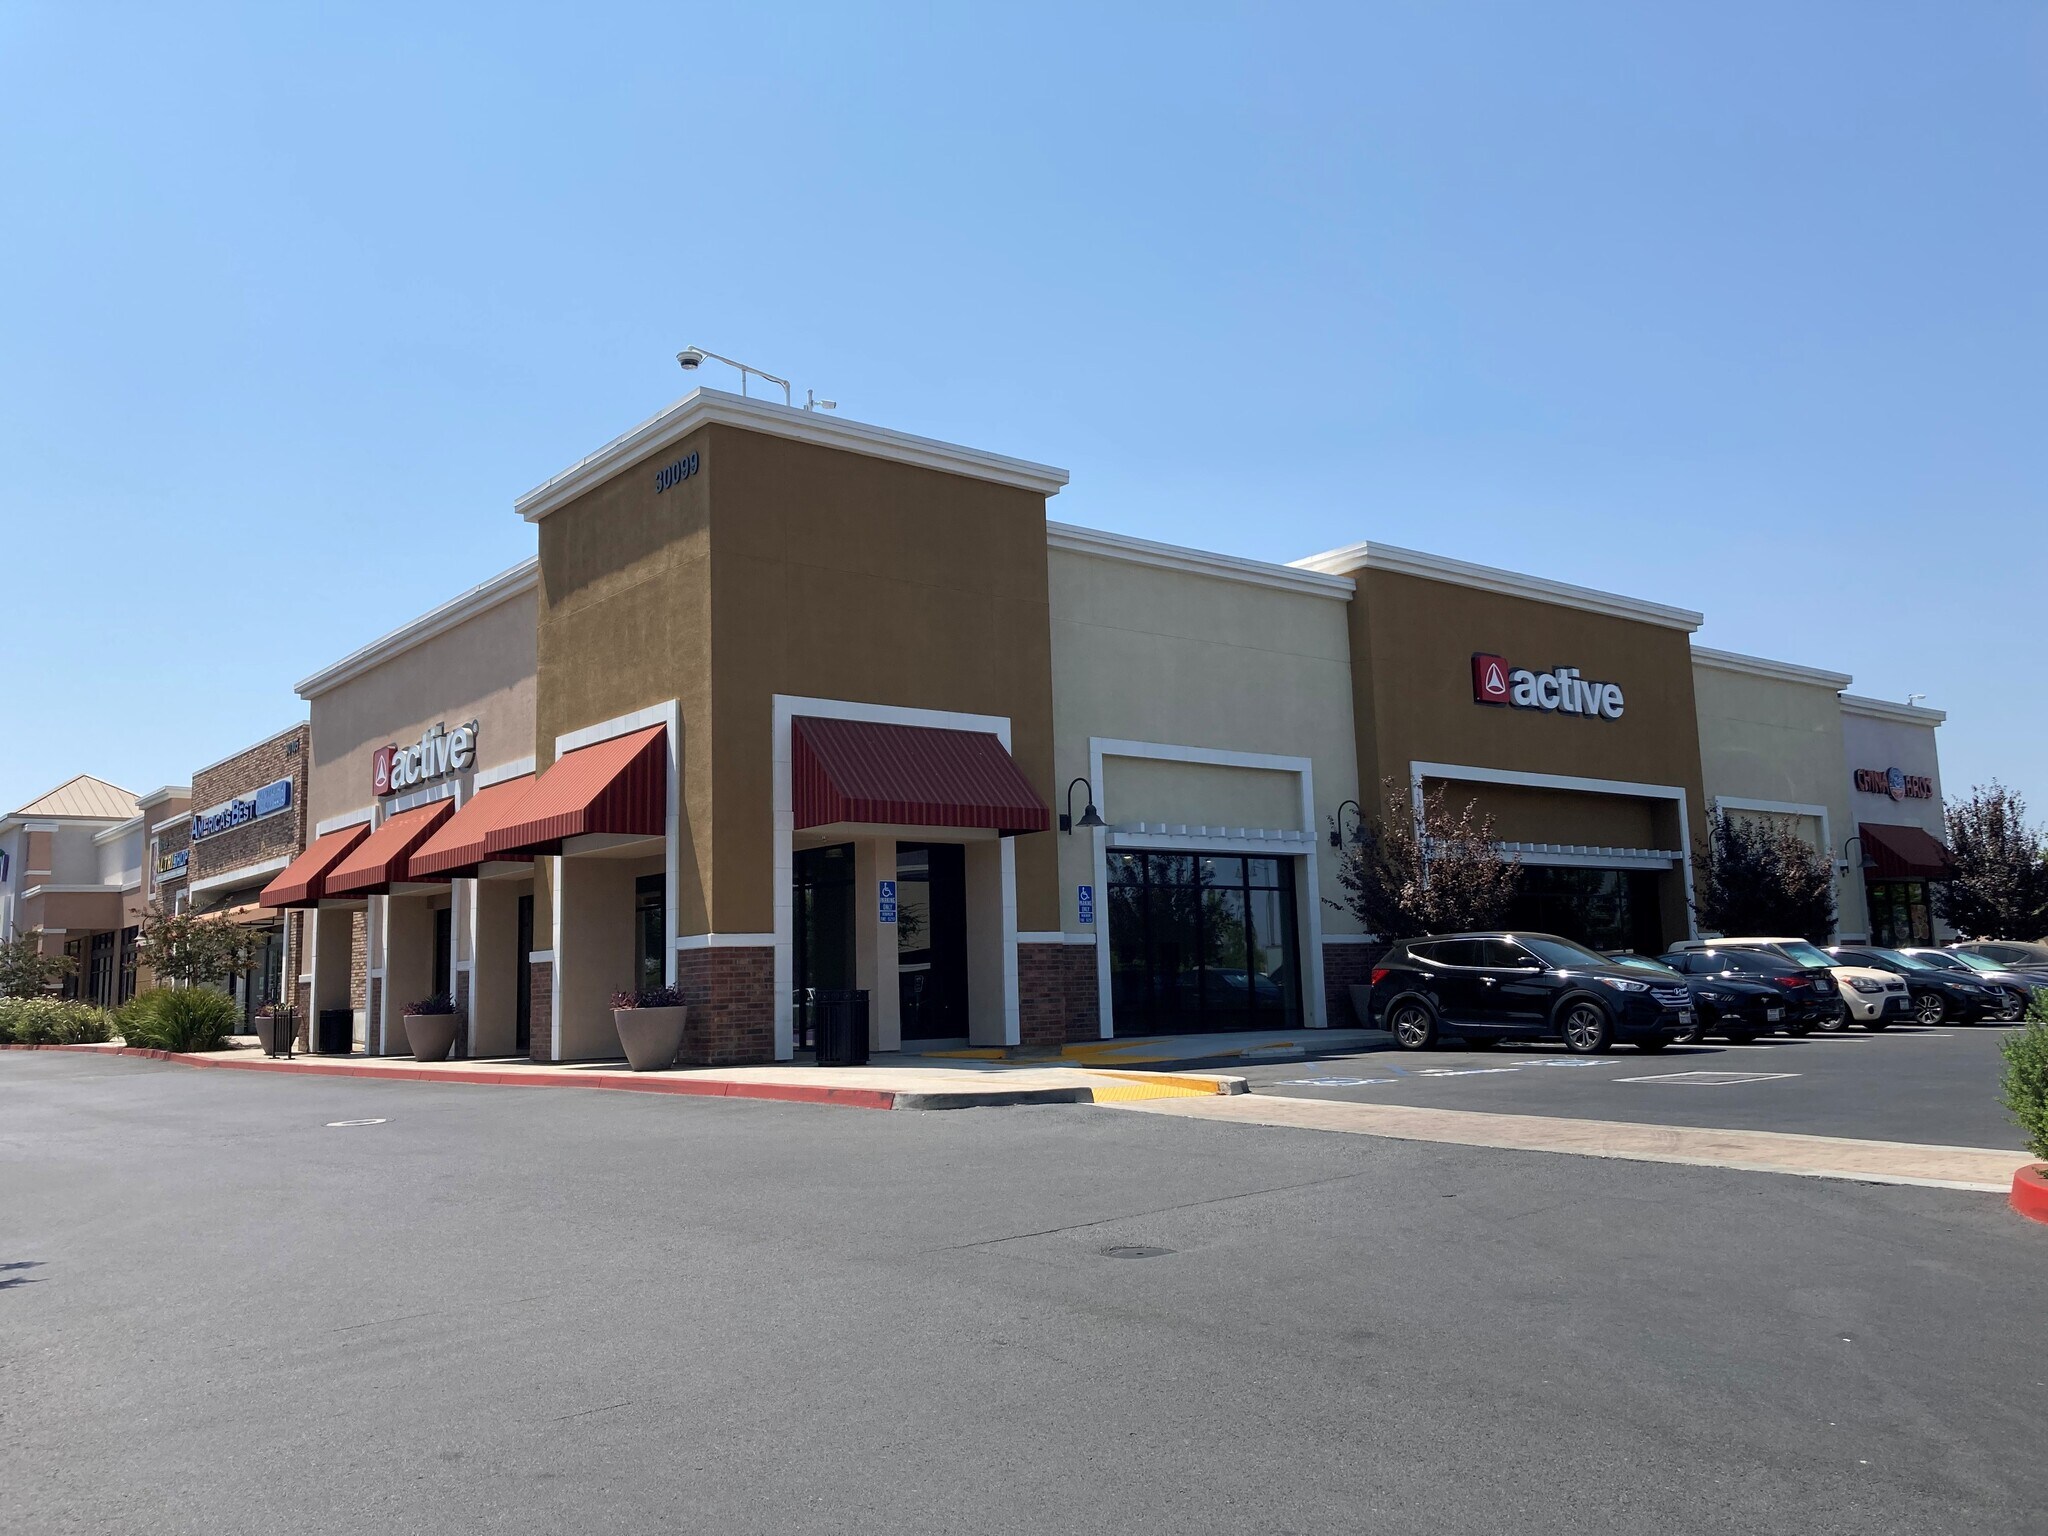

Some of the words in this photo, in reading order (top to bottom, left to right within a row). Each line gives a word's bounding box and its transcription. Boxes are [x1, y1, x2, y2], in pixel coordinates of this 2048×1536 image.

[655, 450, 699, 494] 30099
[1510, 667, 1625, 720] active
[391, 724, 475, 790] active
[1854, 768, 1890, 795] CHINA
[1904, 775, 1934, 799] BROS
[191, 808, 231, 840] AMERICA'S
[231, 798, 257, 827] BEST
[156, 849, 188, 874] NUTRISHOP
